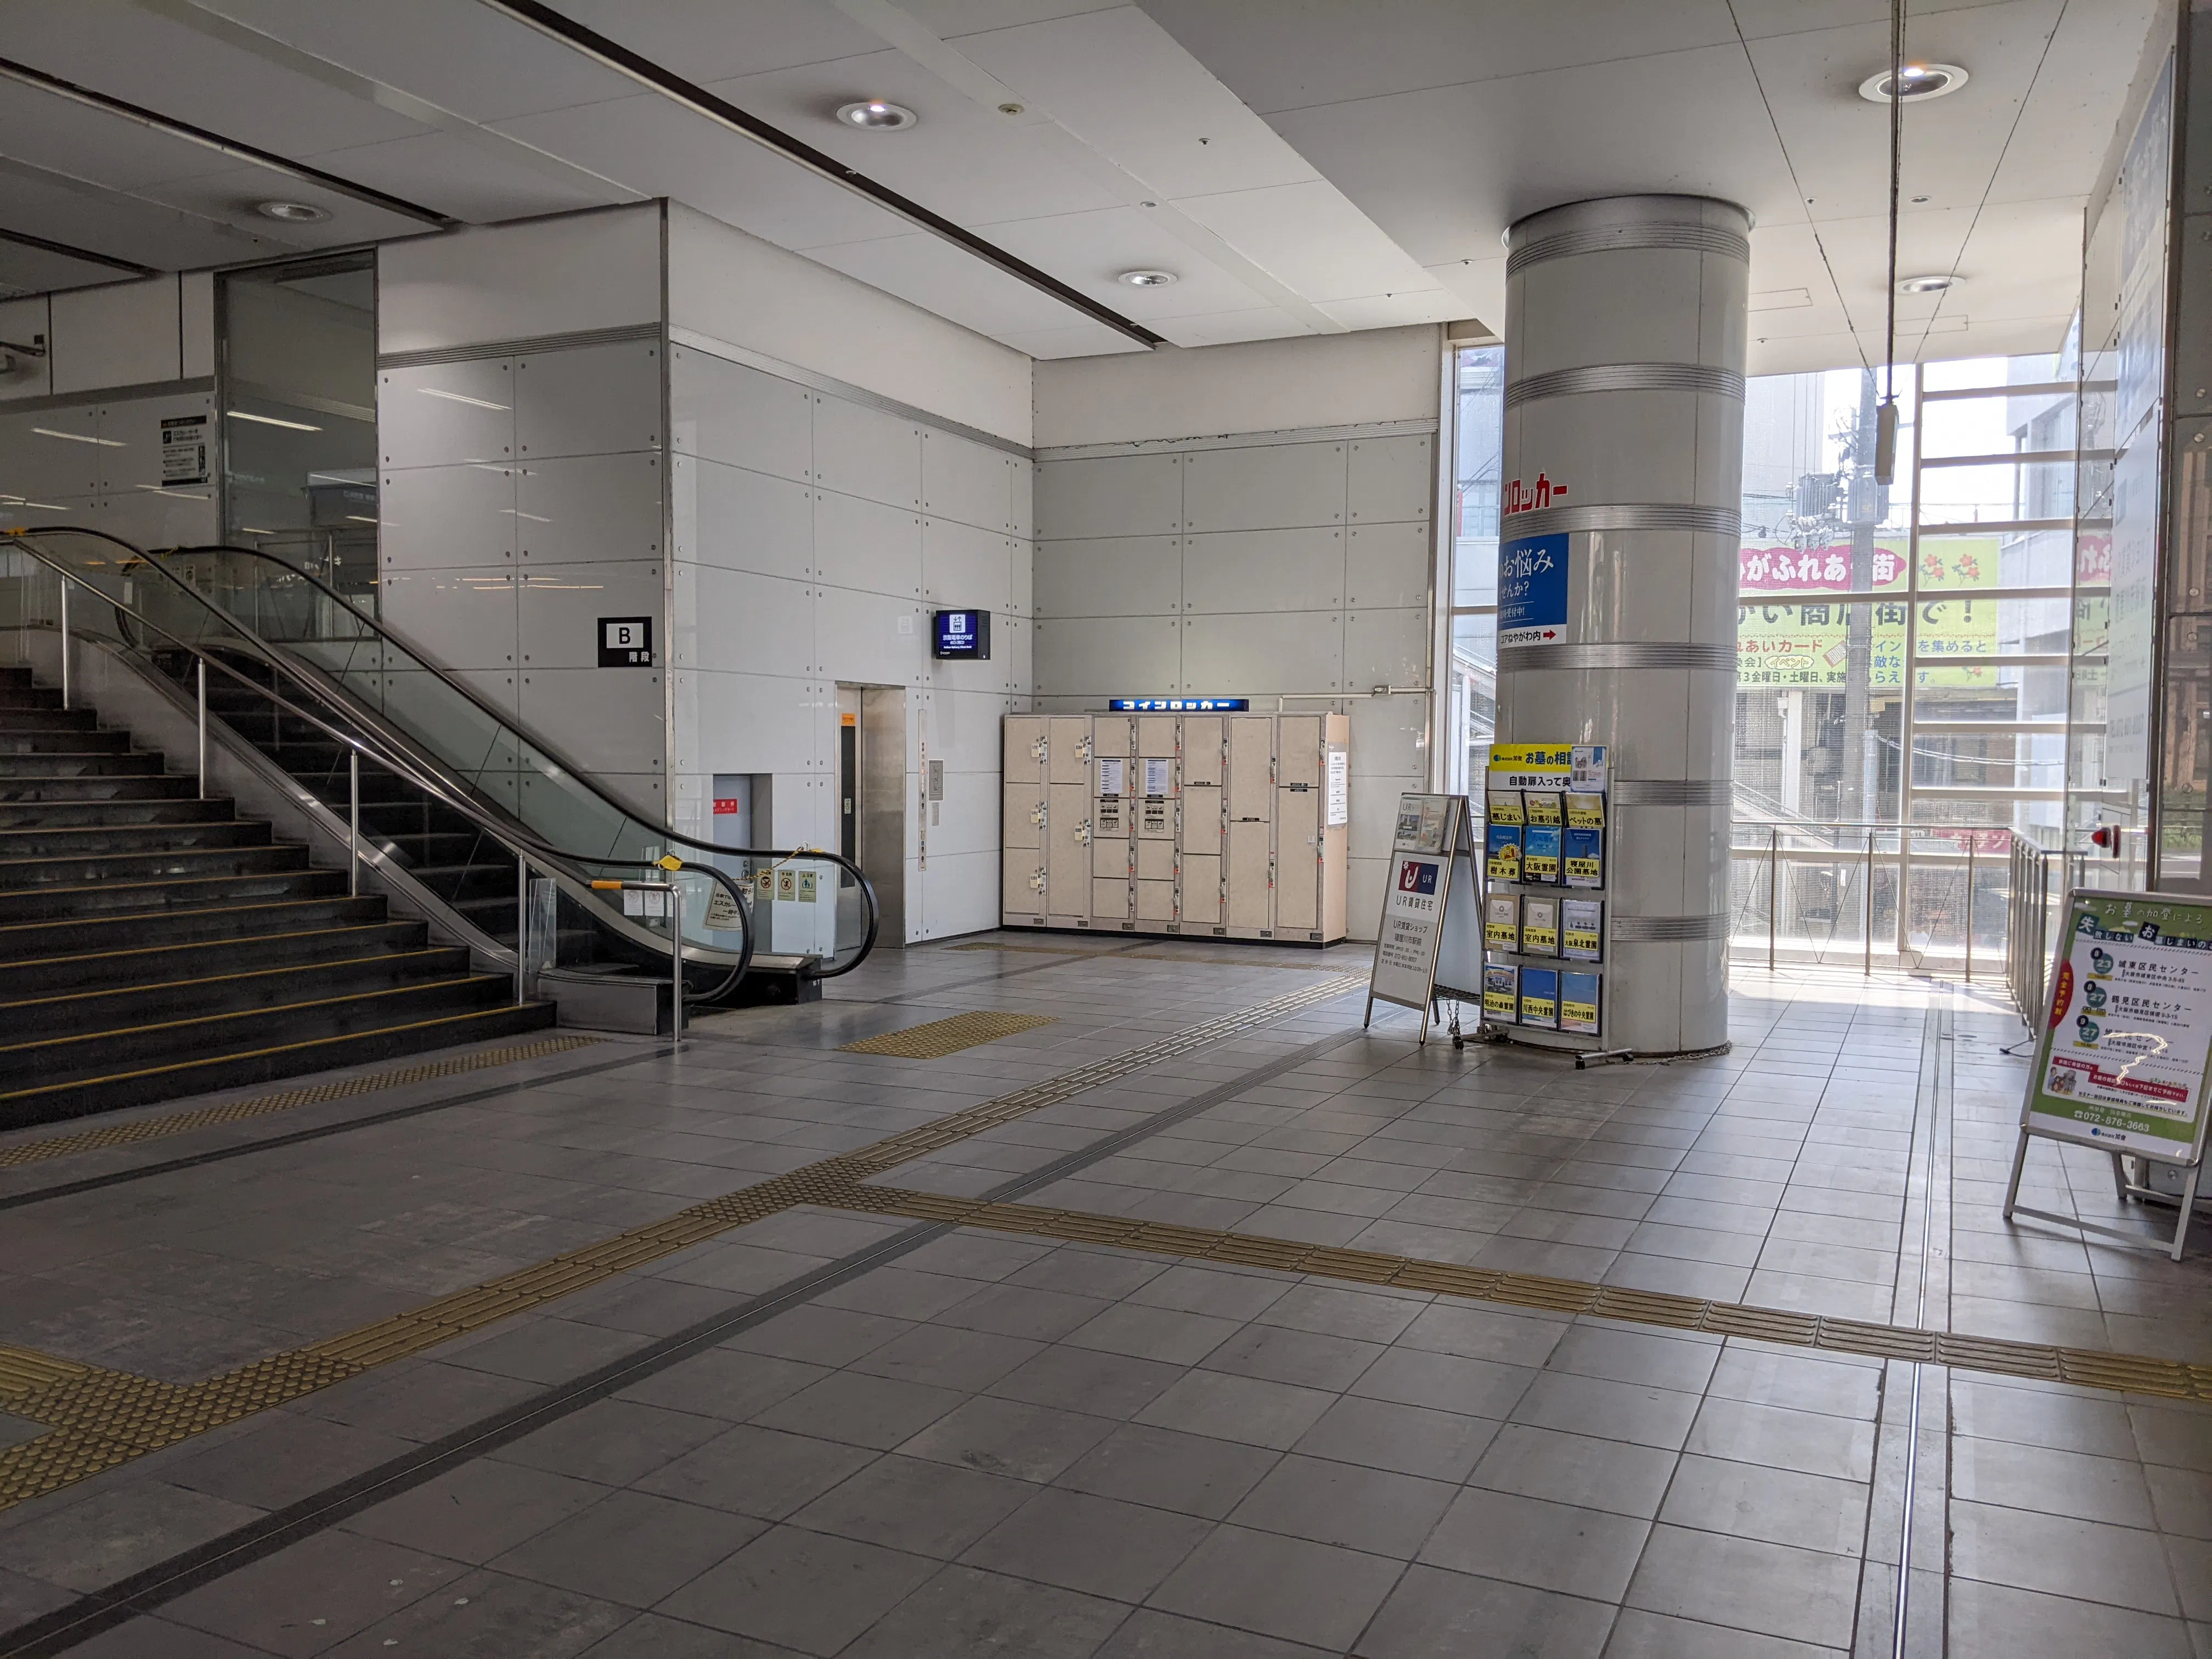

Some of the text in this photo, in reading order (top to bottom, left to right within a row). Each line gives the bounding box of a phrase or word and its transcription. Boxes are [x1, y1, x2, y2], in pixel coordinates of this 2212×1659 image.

[1499, 581, 1529, 599] せんか？
[619, 627, 631, 644] B
[629, 651, 649, 663] 階段
[1770, 658, 1809, 668] イベント
[1123, 701, 1229, 709] コインロッカー
[1492, 812, 1521, 821] 墓じまい
[1530, 815, 1561, 824] お墓引越
[1569, 817, 1602, 825] ペットの墓
[1491, 866, 1515, 876] 樹木葬
[1526, 862, 1556, 873] 大阪霊園
[1566, 867, 1598, 876] 公園墓地
[1423, 874, 1432, 884] UR
[1396, 895, 1433, 911] UR賃貸住宅
[1393, 920, 1427, 933] UR賃貸ショップ
[2080, 916, 2134, 942] 失敗しない
[1395, 933, 1422, 946] 寝屋川市駅前
[1486, 930, 1515, 941] 室内墓地
[1525, 934, 1555, 945] 室内墓地
[1565, 939, 1597, 950] 大阪泉北霊園
[2097, 960, 2112, 968] 23
[2118, 960, 2198, 975] 城東区民センター
[2089, 994, 2104, 1002] 27
[2111, 995, 2192, 1012] 鶴見区民センター
[1485, 999, 1514, 1011] 明治の森霊園
[1522, 1004, 1554, 1016] 川西中央霊園
[1563, 1009, 1594, 1020] はびきの中央霊園
[2082, 1028, 2097, 1036] 27
[2084, 1111, 2150, 1132] 072-876-3663
